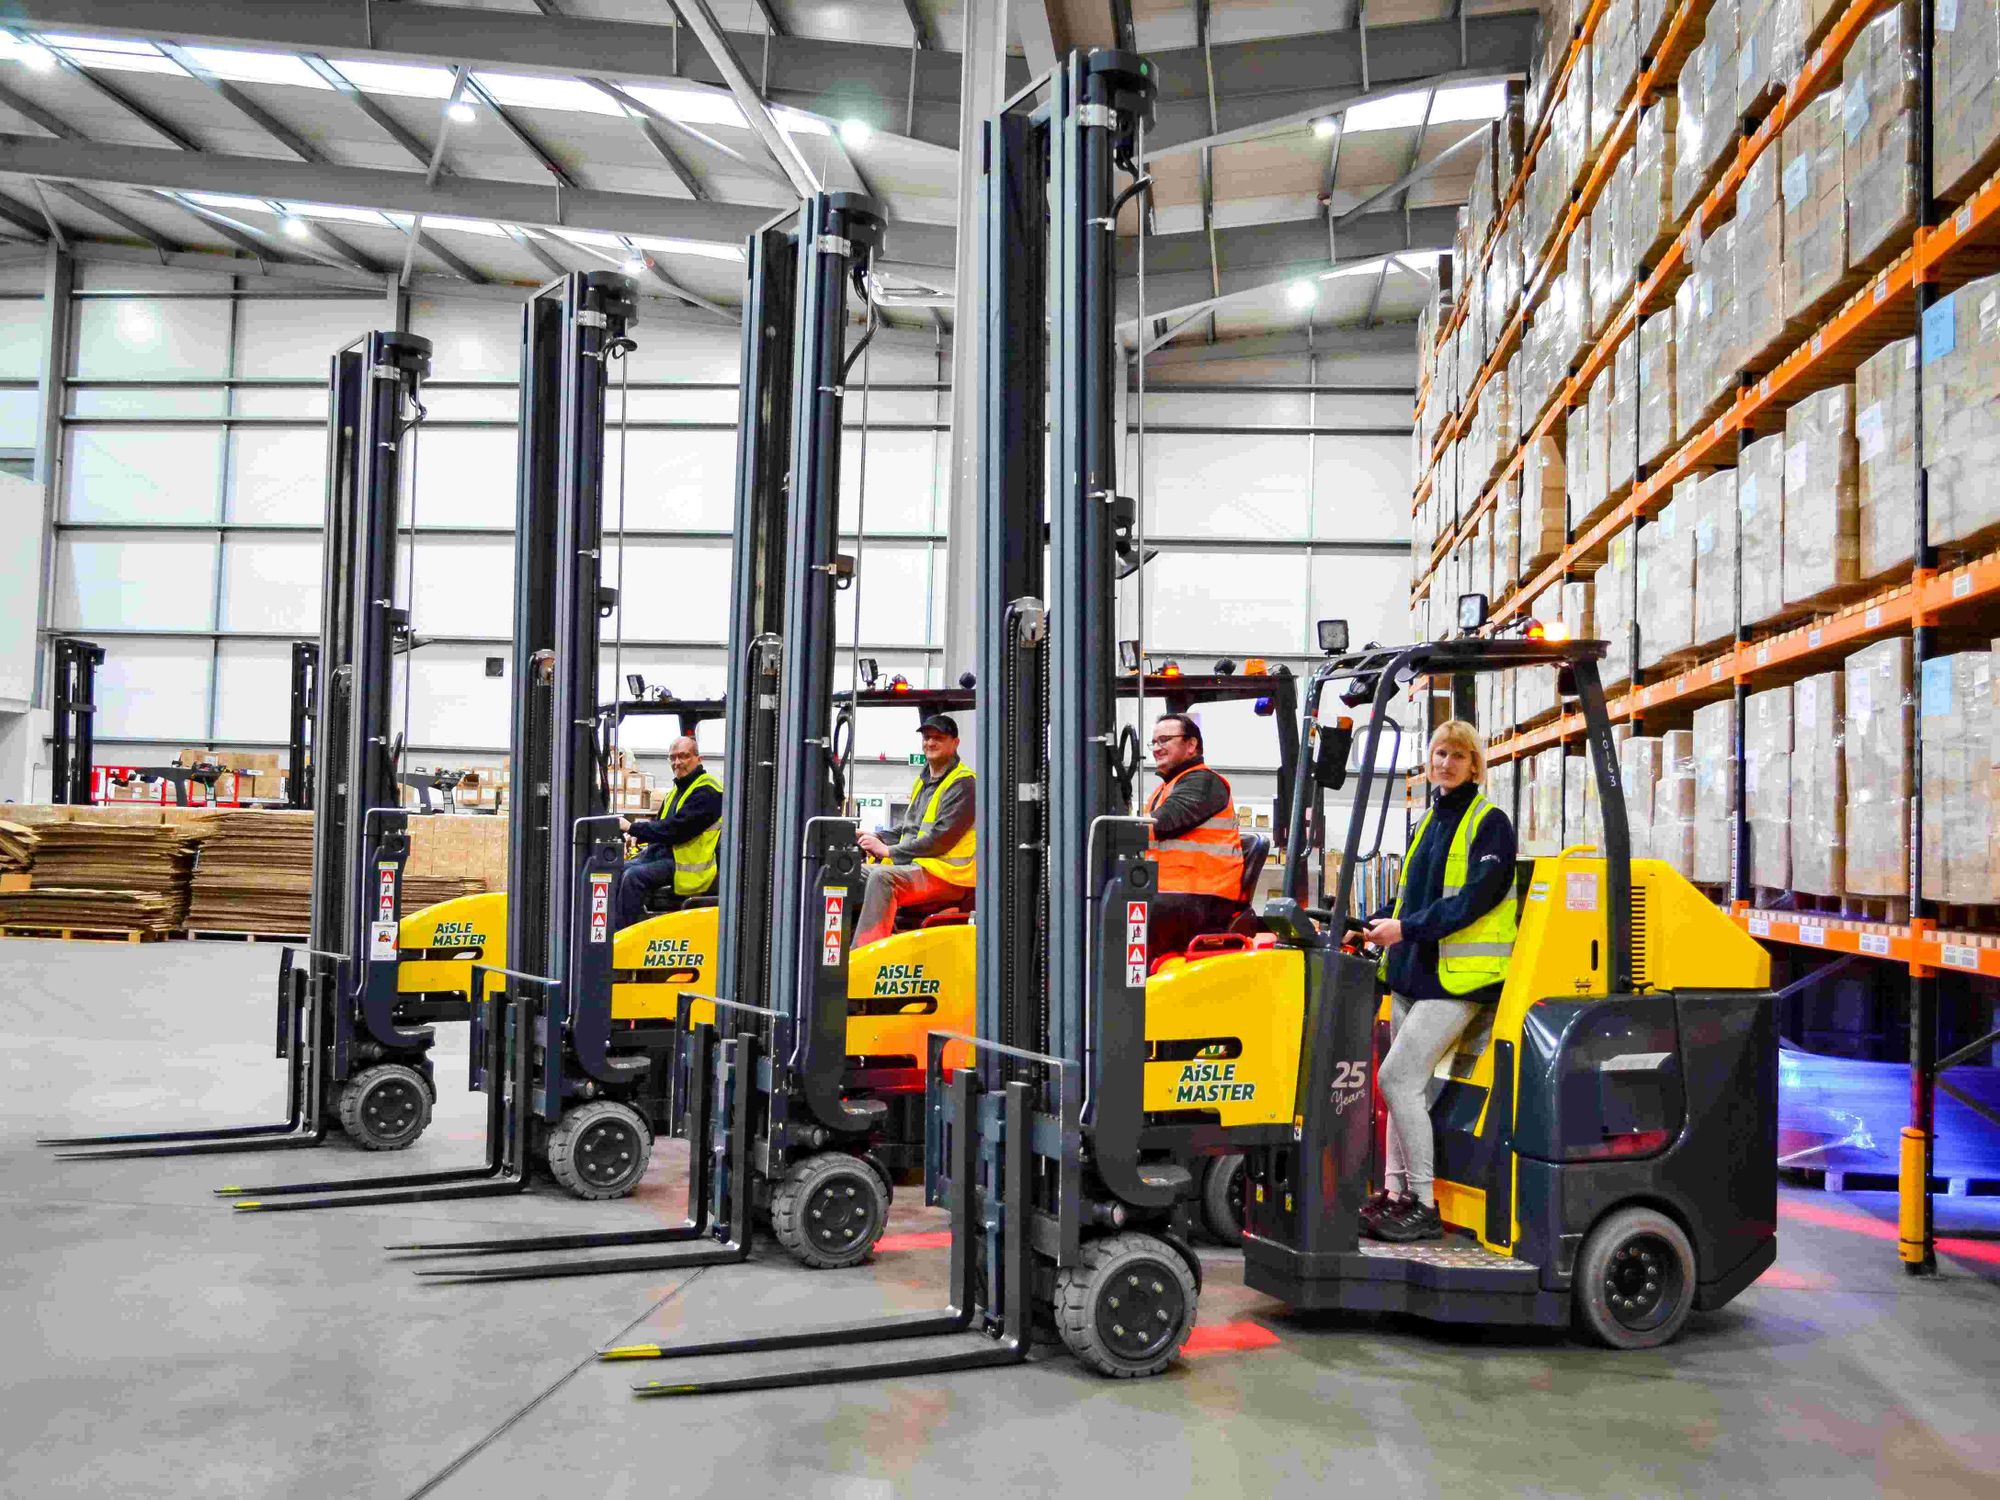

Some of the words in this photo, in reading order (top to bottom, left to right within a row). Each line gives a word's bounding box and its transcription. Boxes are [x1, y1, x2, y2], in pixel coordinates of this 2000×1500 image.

[432, 934, 487, 946] MASTER
[643, 953, 704, 967] MASTER
[873, 980, 940, 995] MASTER
[1330, 1060, 1368, 1089] 25
[1176, 1083, 1256, 1103] MASTER
[1330, 1088, 1367, 1115] Years
